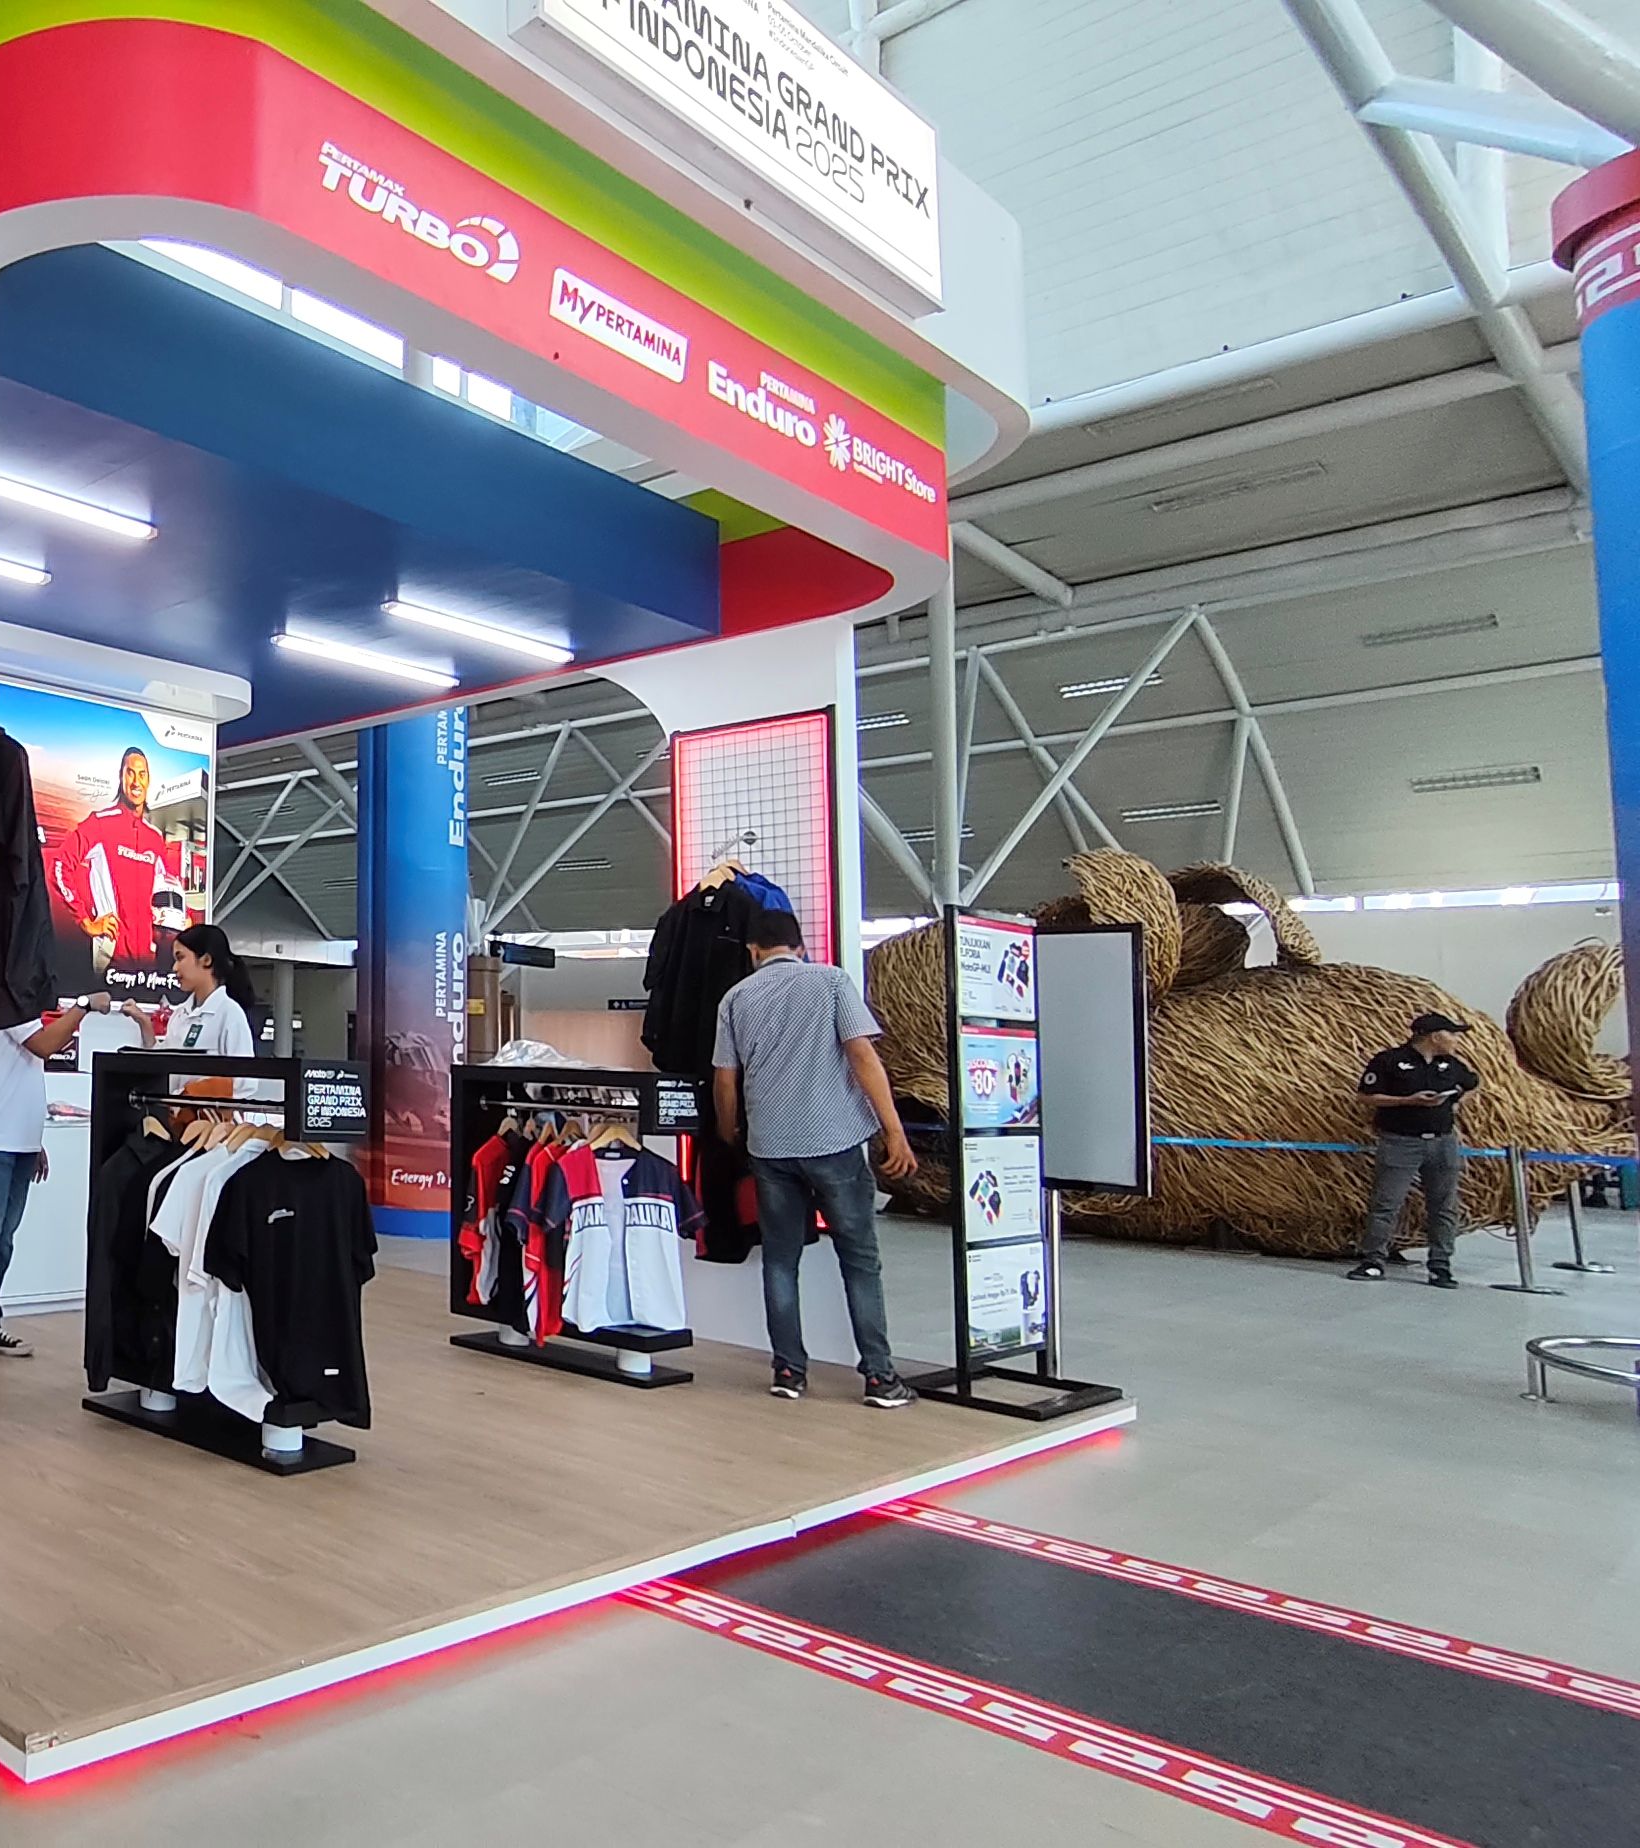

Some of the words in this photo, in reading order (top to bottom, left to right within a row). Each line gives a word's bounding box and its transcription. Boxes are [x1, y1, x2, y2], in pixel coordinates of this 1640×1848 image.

[629, 0, 790, 150] INDONESIA
[796, 125, 865, 204] 2025
[321, 141, 406, 197] PERTAMAX
[777, 71, 865, 163] GRAND
[871, 143, 931, 219] PRIX
[318, 154, 490, 268] TURBO
[708, 359, 817, 448] Enduro
[106, 968, 137, 989] Energy
[435, 931, 448, 1018] PERTAMINA
[447, 932, 465, 1098] nduro
[307, 1083, 362, 1096] PERTAMINA
[307, 1095, 339, 1106] GRAND
[340, 1096, 363, 1107] PRIX
[307, 1105, 320, 1116] OF
[320, 1106, 367, 1118] INDONESIA
[307, 1116, 332, 1128] 2025
[391, 1168, 434, 1191] Energy
[436, 1170, 447, 1185] to
